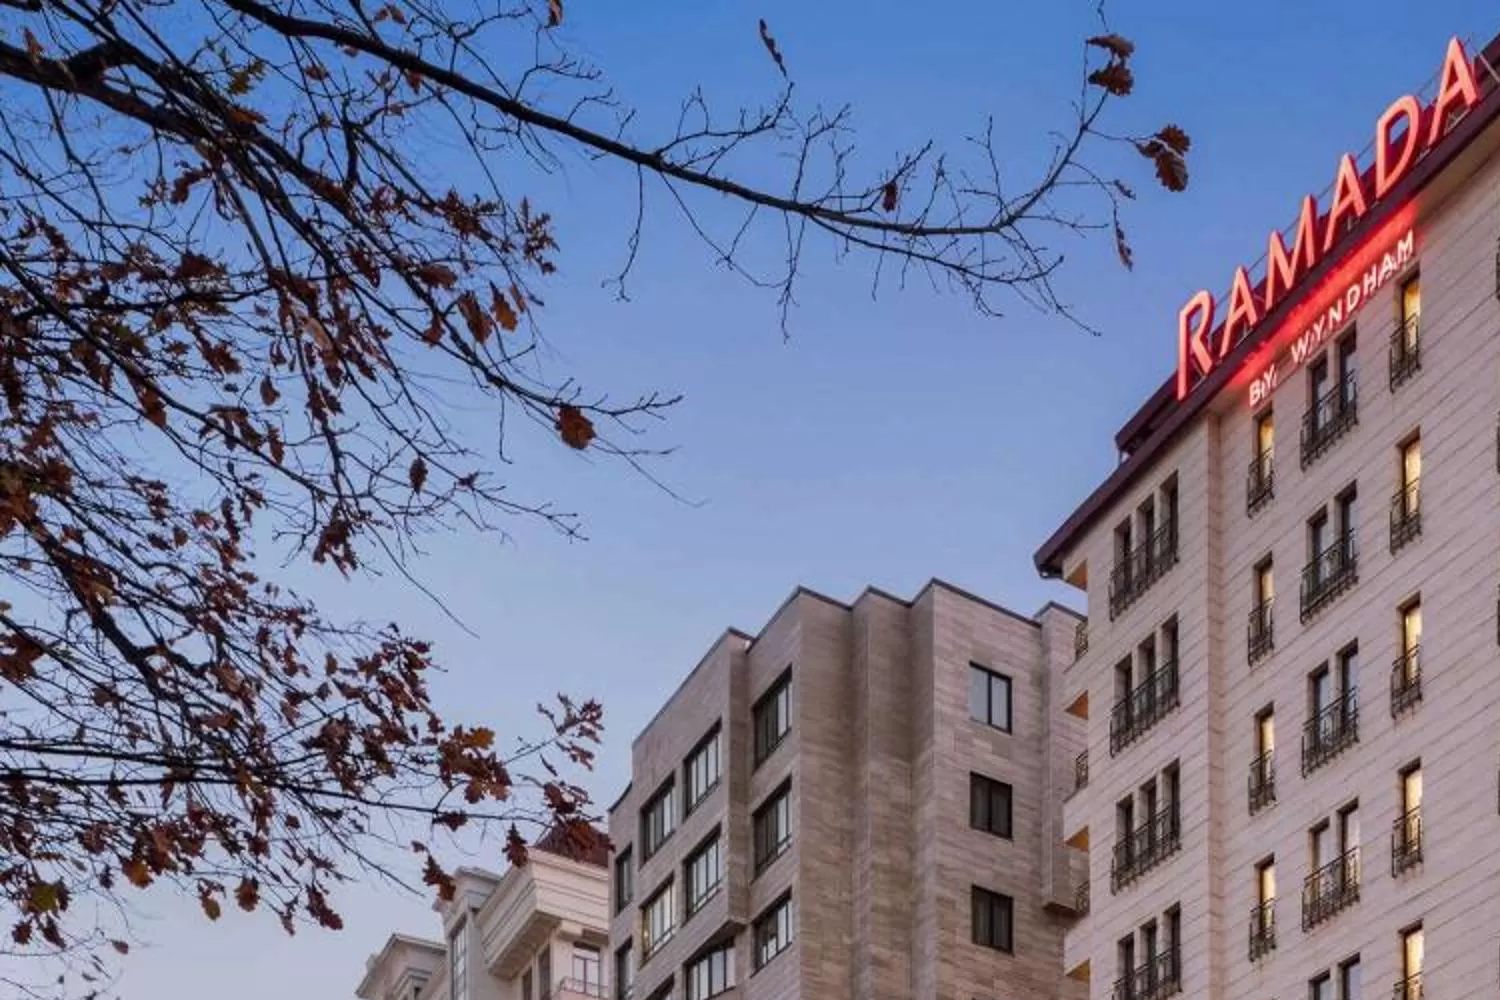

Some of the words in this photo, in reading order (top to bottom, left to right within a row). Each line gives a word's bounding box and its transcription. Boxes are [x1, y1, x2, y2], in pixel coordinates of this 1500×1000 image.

[1177, 36, 1479, 401] RAMADA
[1249, 363, 1277, 406] BY
[1291, 229, 1414, 364] WYNDHAM
